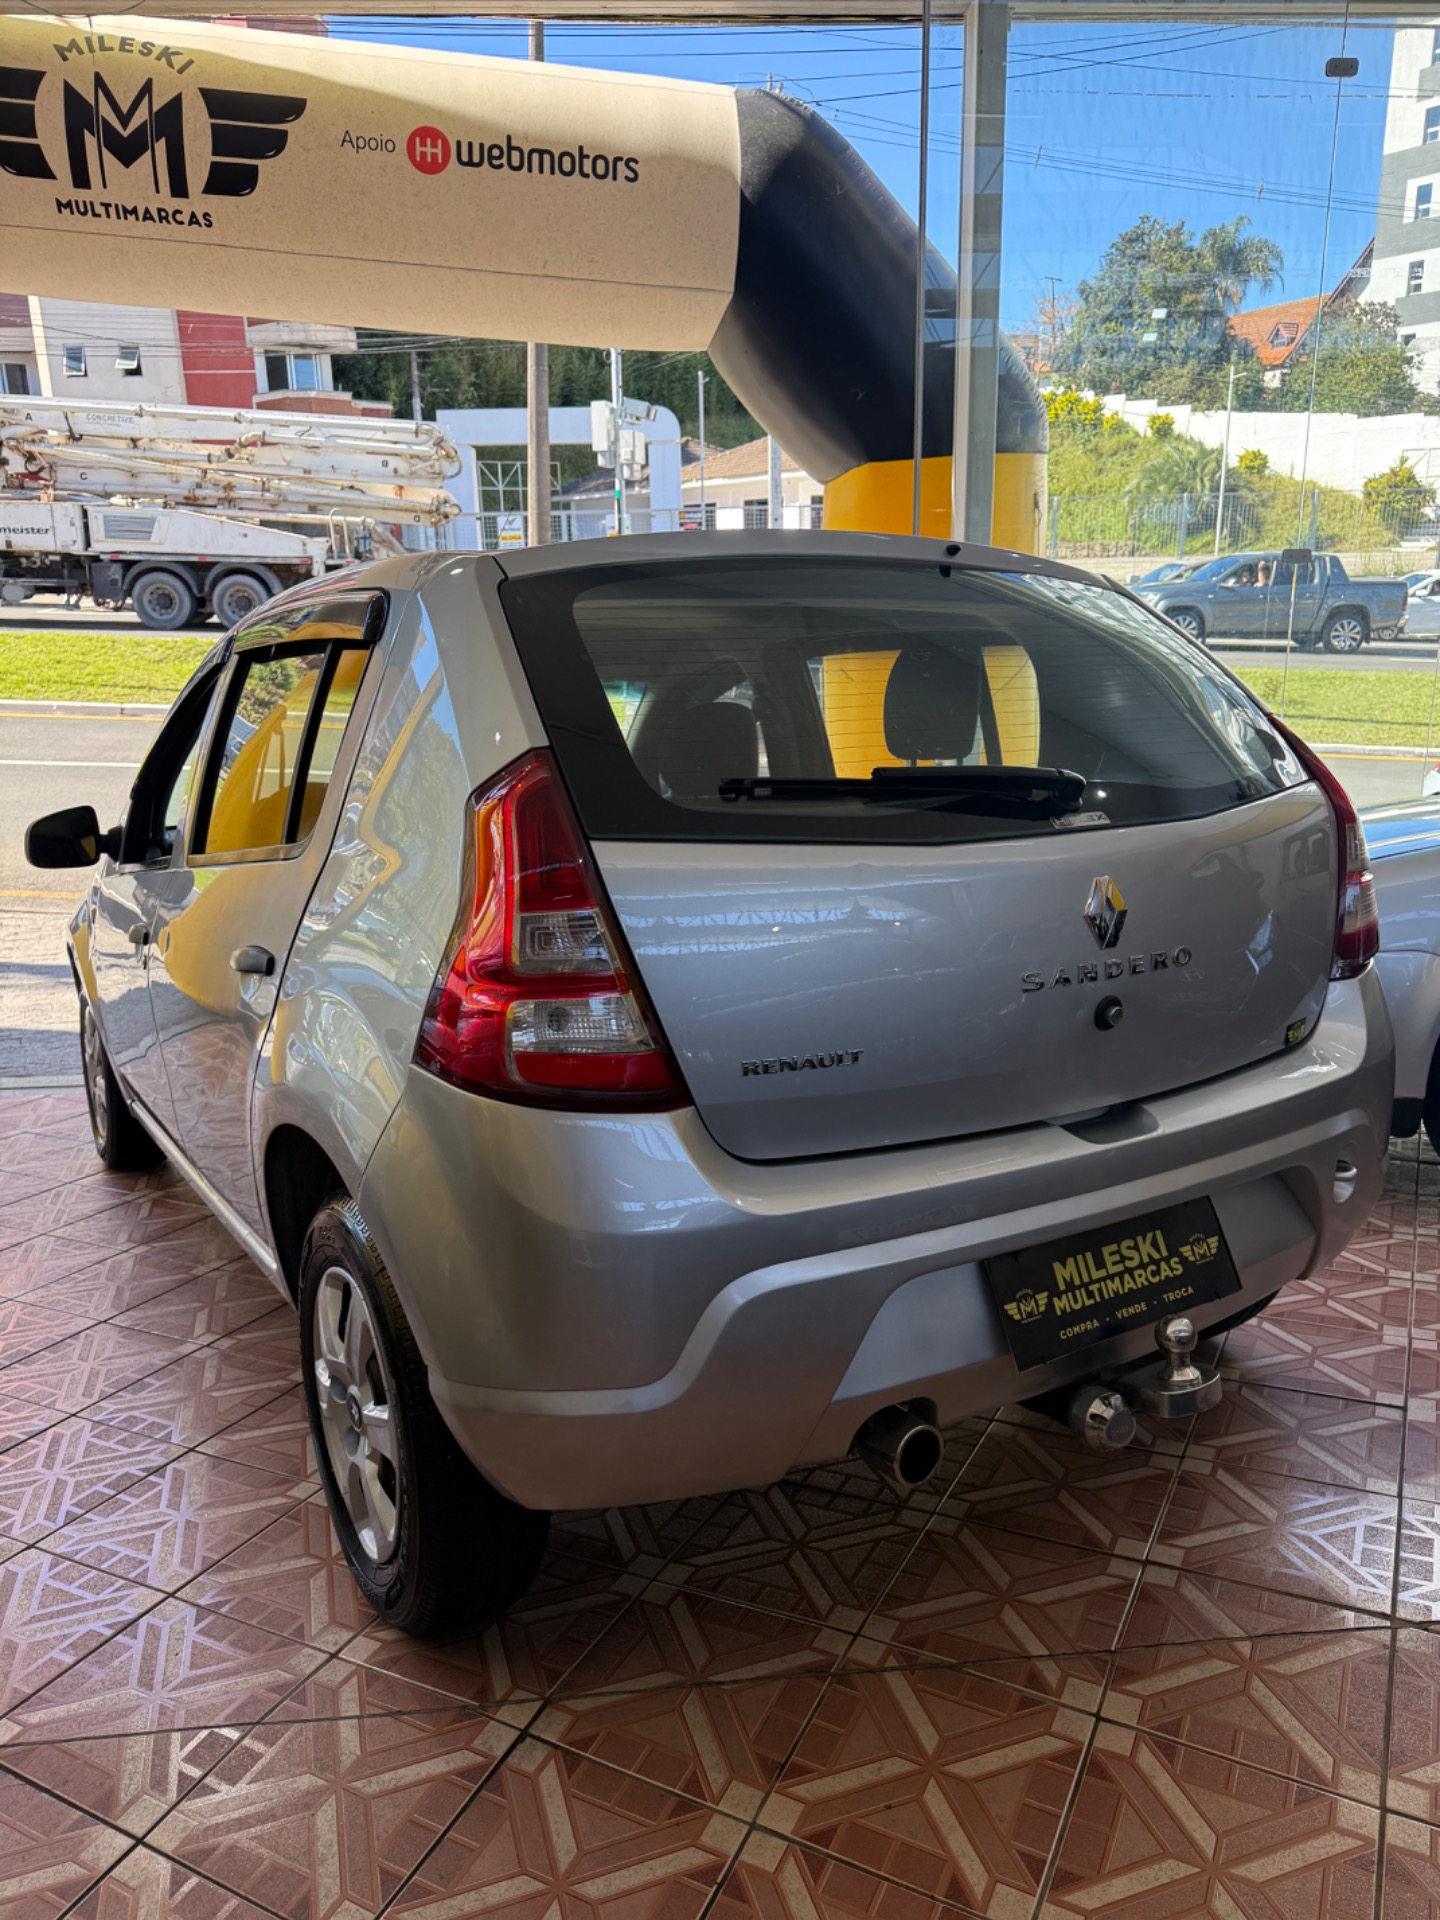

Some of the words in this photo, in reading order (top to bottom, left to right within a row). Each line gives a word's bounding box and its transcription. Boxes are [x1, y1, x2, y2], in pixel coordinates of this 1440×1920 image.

[53, 35, 195, 75] MILESKI
[340, 130, 397, 154] Apoio
[455, 134, 640, 183] webmotors
[54, 197, 213, 228] MULTIMARCAS
[25, 412, 33, 421] A
[79, 471, 88, 481] C
[1021, 945, 1192, 993] SANDERO
[741, 1048, 864, 1077] RENAULT
[1052, 1229, 1169, 1291] MILESKI
[1052, 1257, 1184, 1317] MULTIMARCAS
[1059, 1319, 1100, 1340] COMPRA
[1115, 1301, 1148, 1320] VENDE
[1162, 1285, 1195, 1304] TROCA
